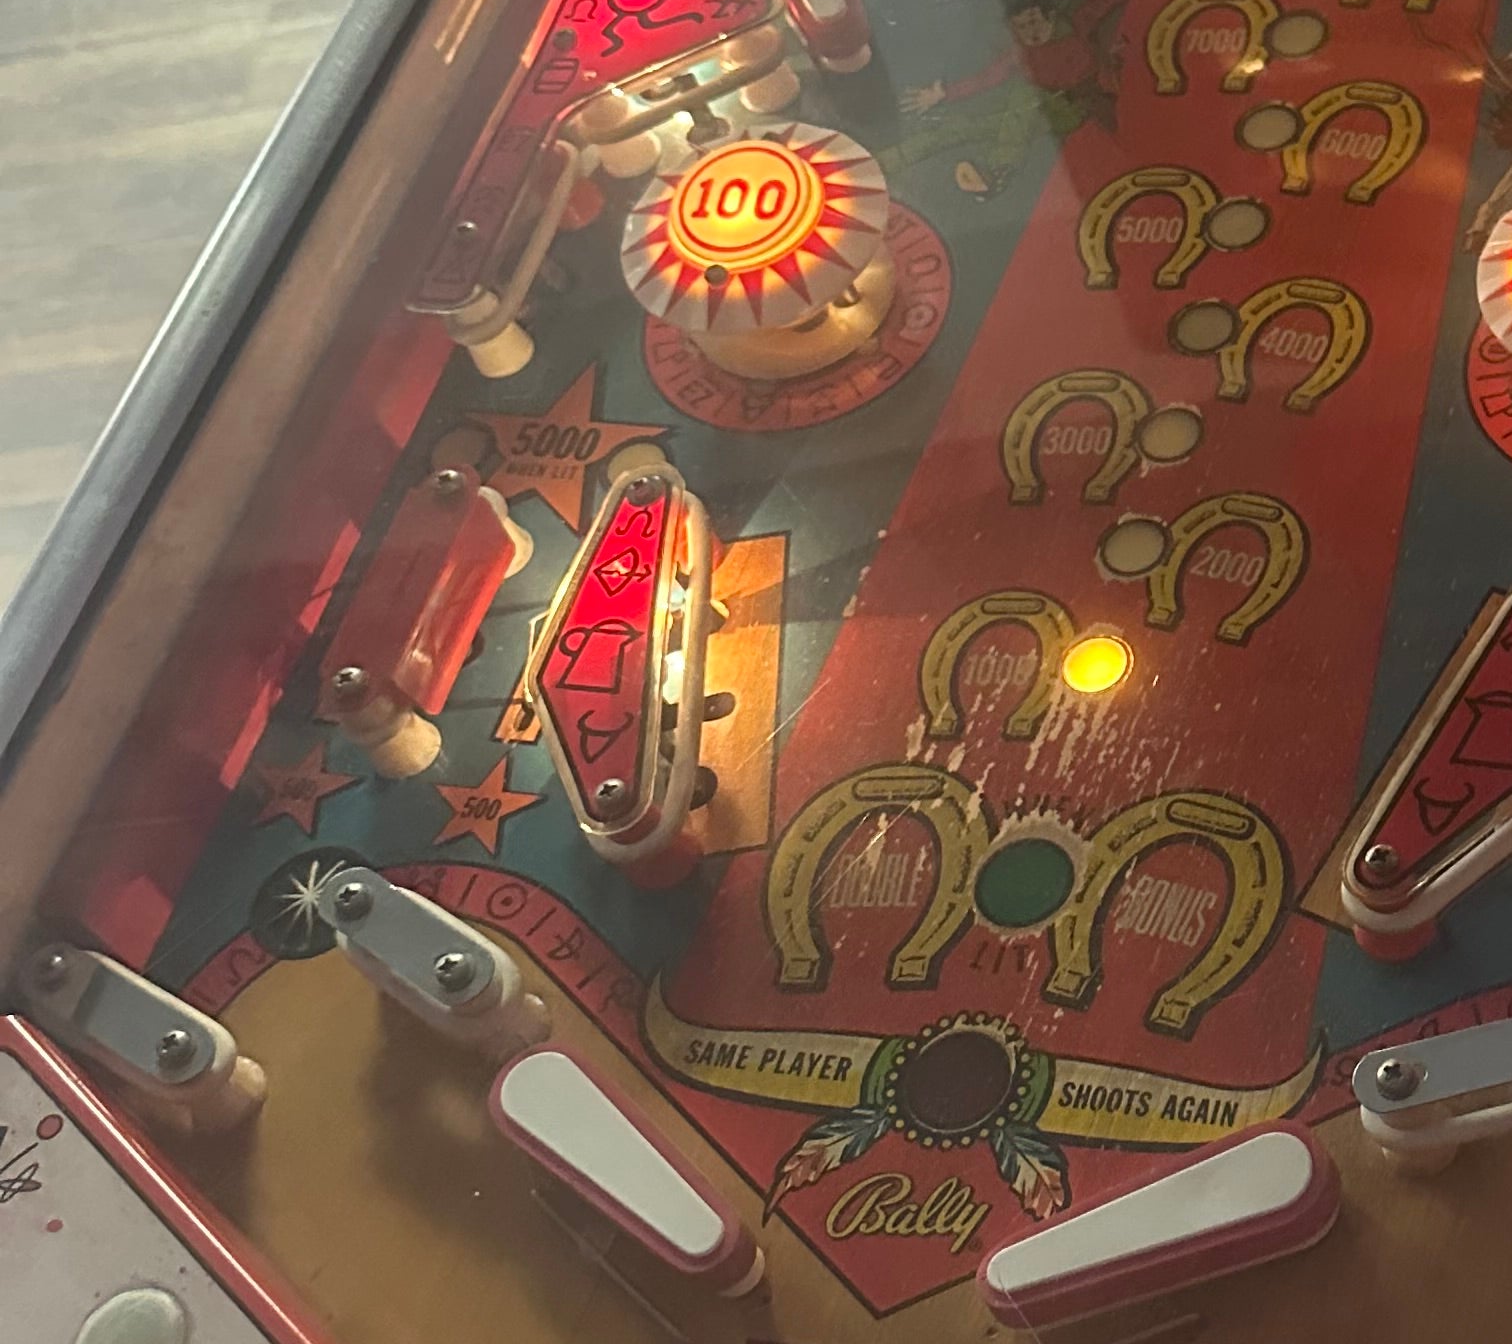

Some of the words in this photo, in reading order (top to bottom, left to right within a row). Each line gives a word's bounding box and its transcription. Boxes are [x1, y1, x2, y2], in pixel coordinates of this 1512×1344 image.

[690, 178, 788, 221] 100
[1116, 216, 1185, 244] 5000
[1258, 325, 1329, 363] 4000
[511, 422, 601, 461] 5000
[1041, 425, 1112, 456] 3000
[1190, 545, 1266, 587] 2000
[462, 795, 501, 820] 500
[682, 1039, 751, 1072] SAME
[759, 1048, 853, 1083] PLAYER
[1057, 1081, 1152, 1118] SHOOTS
[1160, 1093, 1239, 1128] AGAIN
[824, 1171, 992, 1255] Bally
